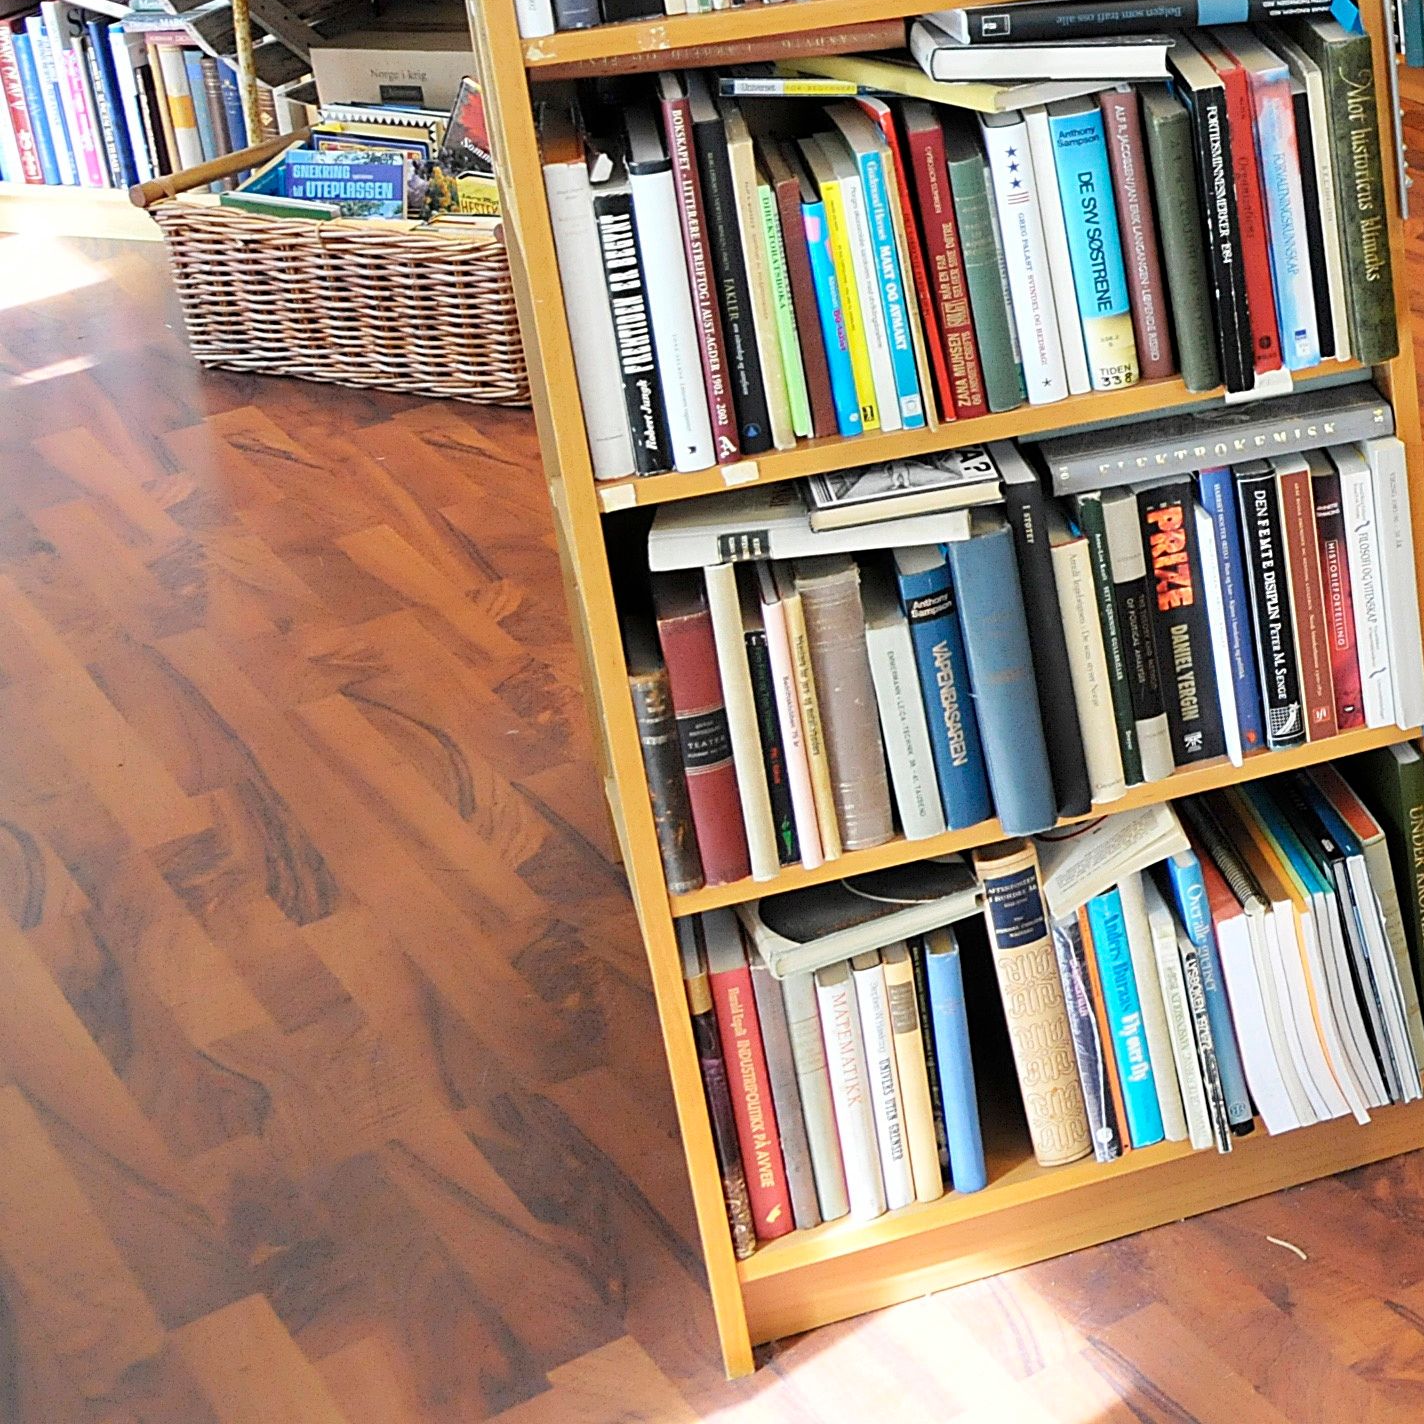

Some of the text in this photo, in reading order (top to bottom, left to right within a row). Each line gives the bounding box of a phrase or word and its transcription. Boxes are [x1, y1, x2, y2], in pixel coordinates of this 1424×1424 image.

[292, 165, 350, 178] SNEKRING
[1056, 135, 1100, 149] Sampson
[1059, 126, 1095, 142] Anthony
[1338, 63, 1386, 281] Mot historiens klimaks
[305, 181, 393, 199] UTEPLASSEN
[597, 210, 636, 268] BEGYNT
[671, 109, 728, 424] BOKSKAPET LITTERÆRE STREIFTOG AUST-AGDER 1902 2002
[1077, 171, 1113, 312] DE SYV SØSTRENE
[612, 294, 653, 374] FREMTIDEN
[722, 277, 740, 320] FAKLER
[946, 331, 970, 407] ZANA MUHSEN
[1100, 366, 1131, 376] TIDEN
[1145, 503, 1196, 611] PRIZE
[1253, 489, 1280, 619] DEN FEMTE DISIPLIN
[910, 601, 952, 618] Sampson
[912, 593, 948, 609] Anthony
[930, 640, 969, 766] VÅPENBASAREN
[1169, 623, 1201, 720] DANIEL YERGIN
[831, 992, 862, 1107] MATEMATIKK
